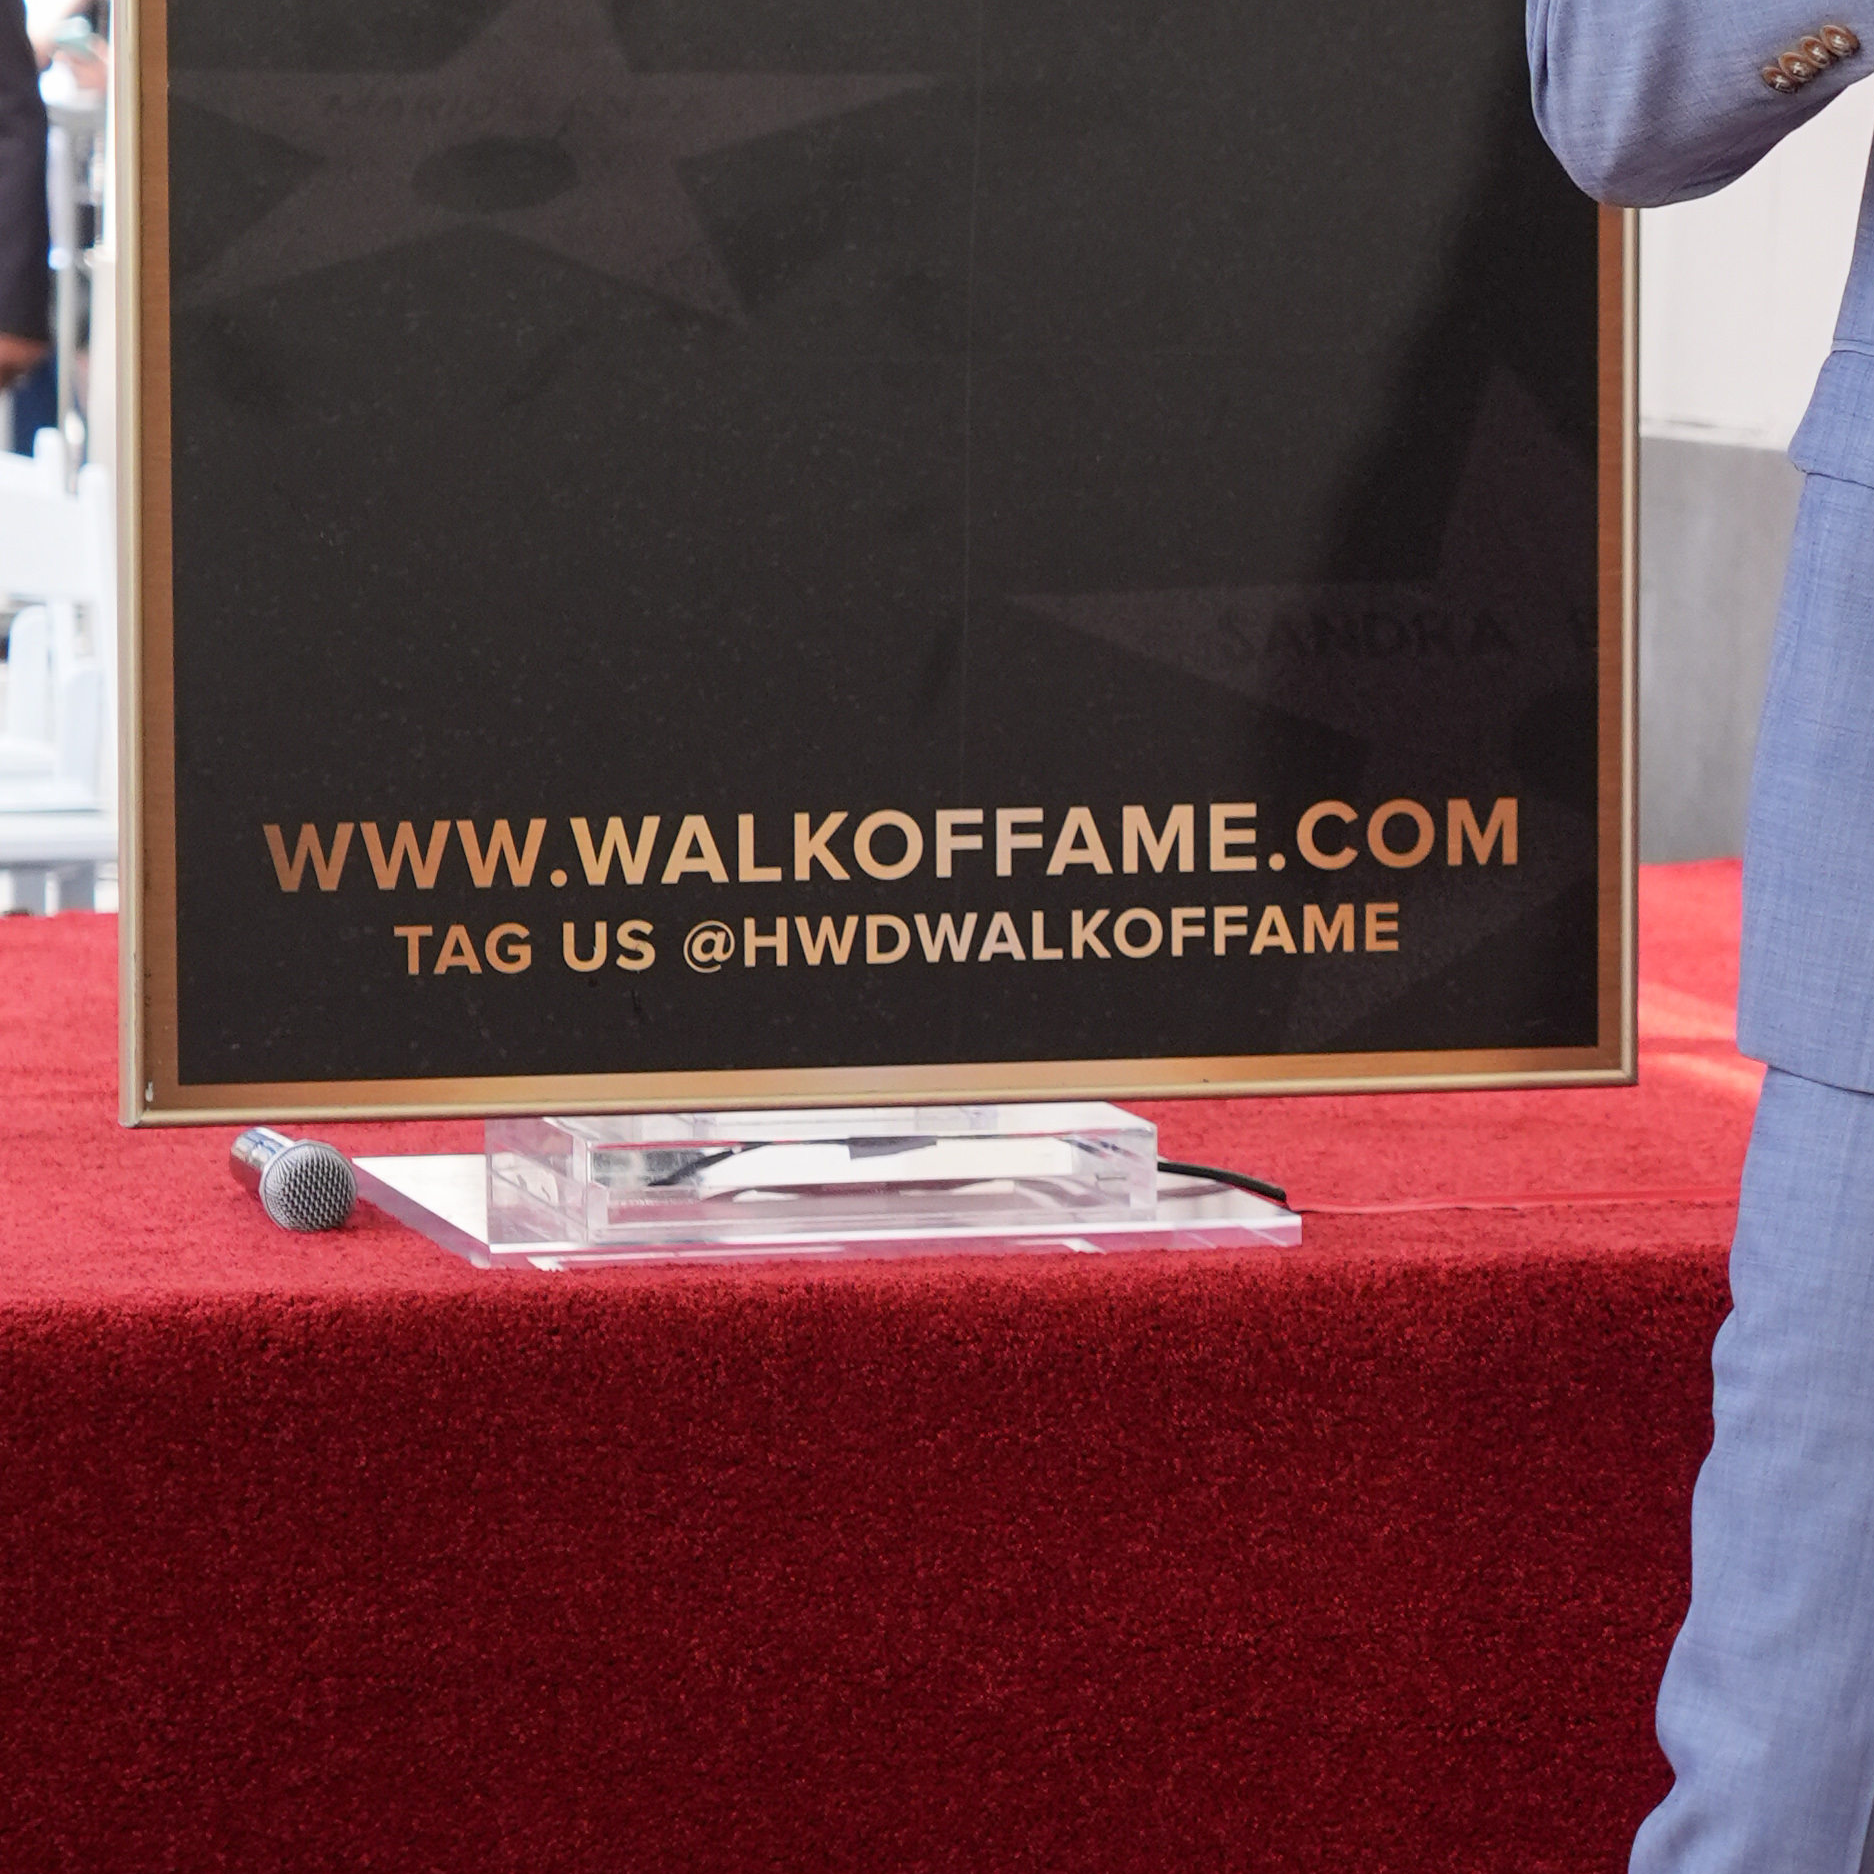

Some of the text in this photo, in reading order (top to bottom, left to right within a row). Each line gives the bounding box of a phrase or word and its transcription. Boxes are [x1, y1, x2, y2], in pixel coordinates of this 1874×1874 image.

[265, 800, 1516, 890] WWW.WALKOFFAME.COM
[394, 904, 1398, 975] TAG US @HWDWALKOFFAME
